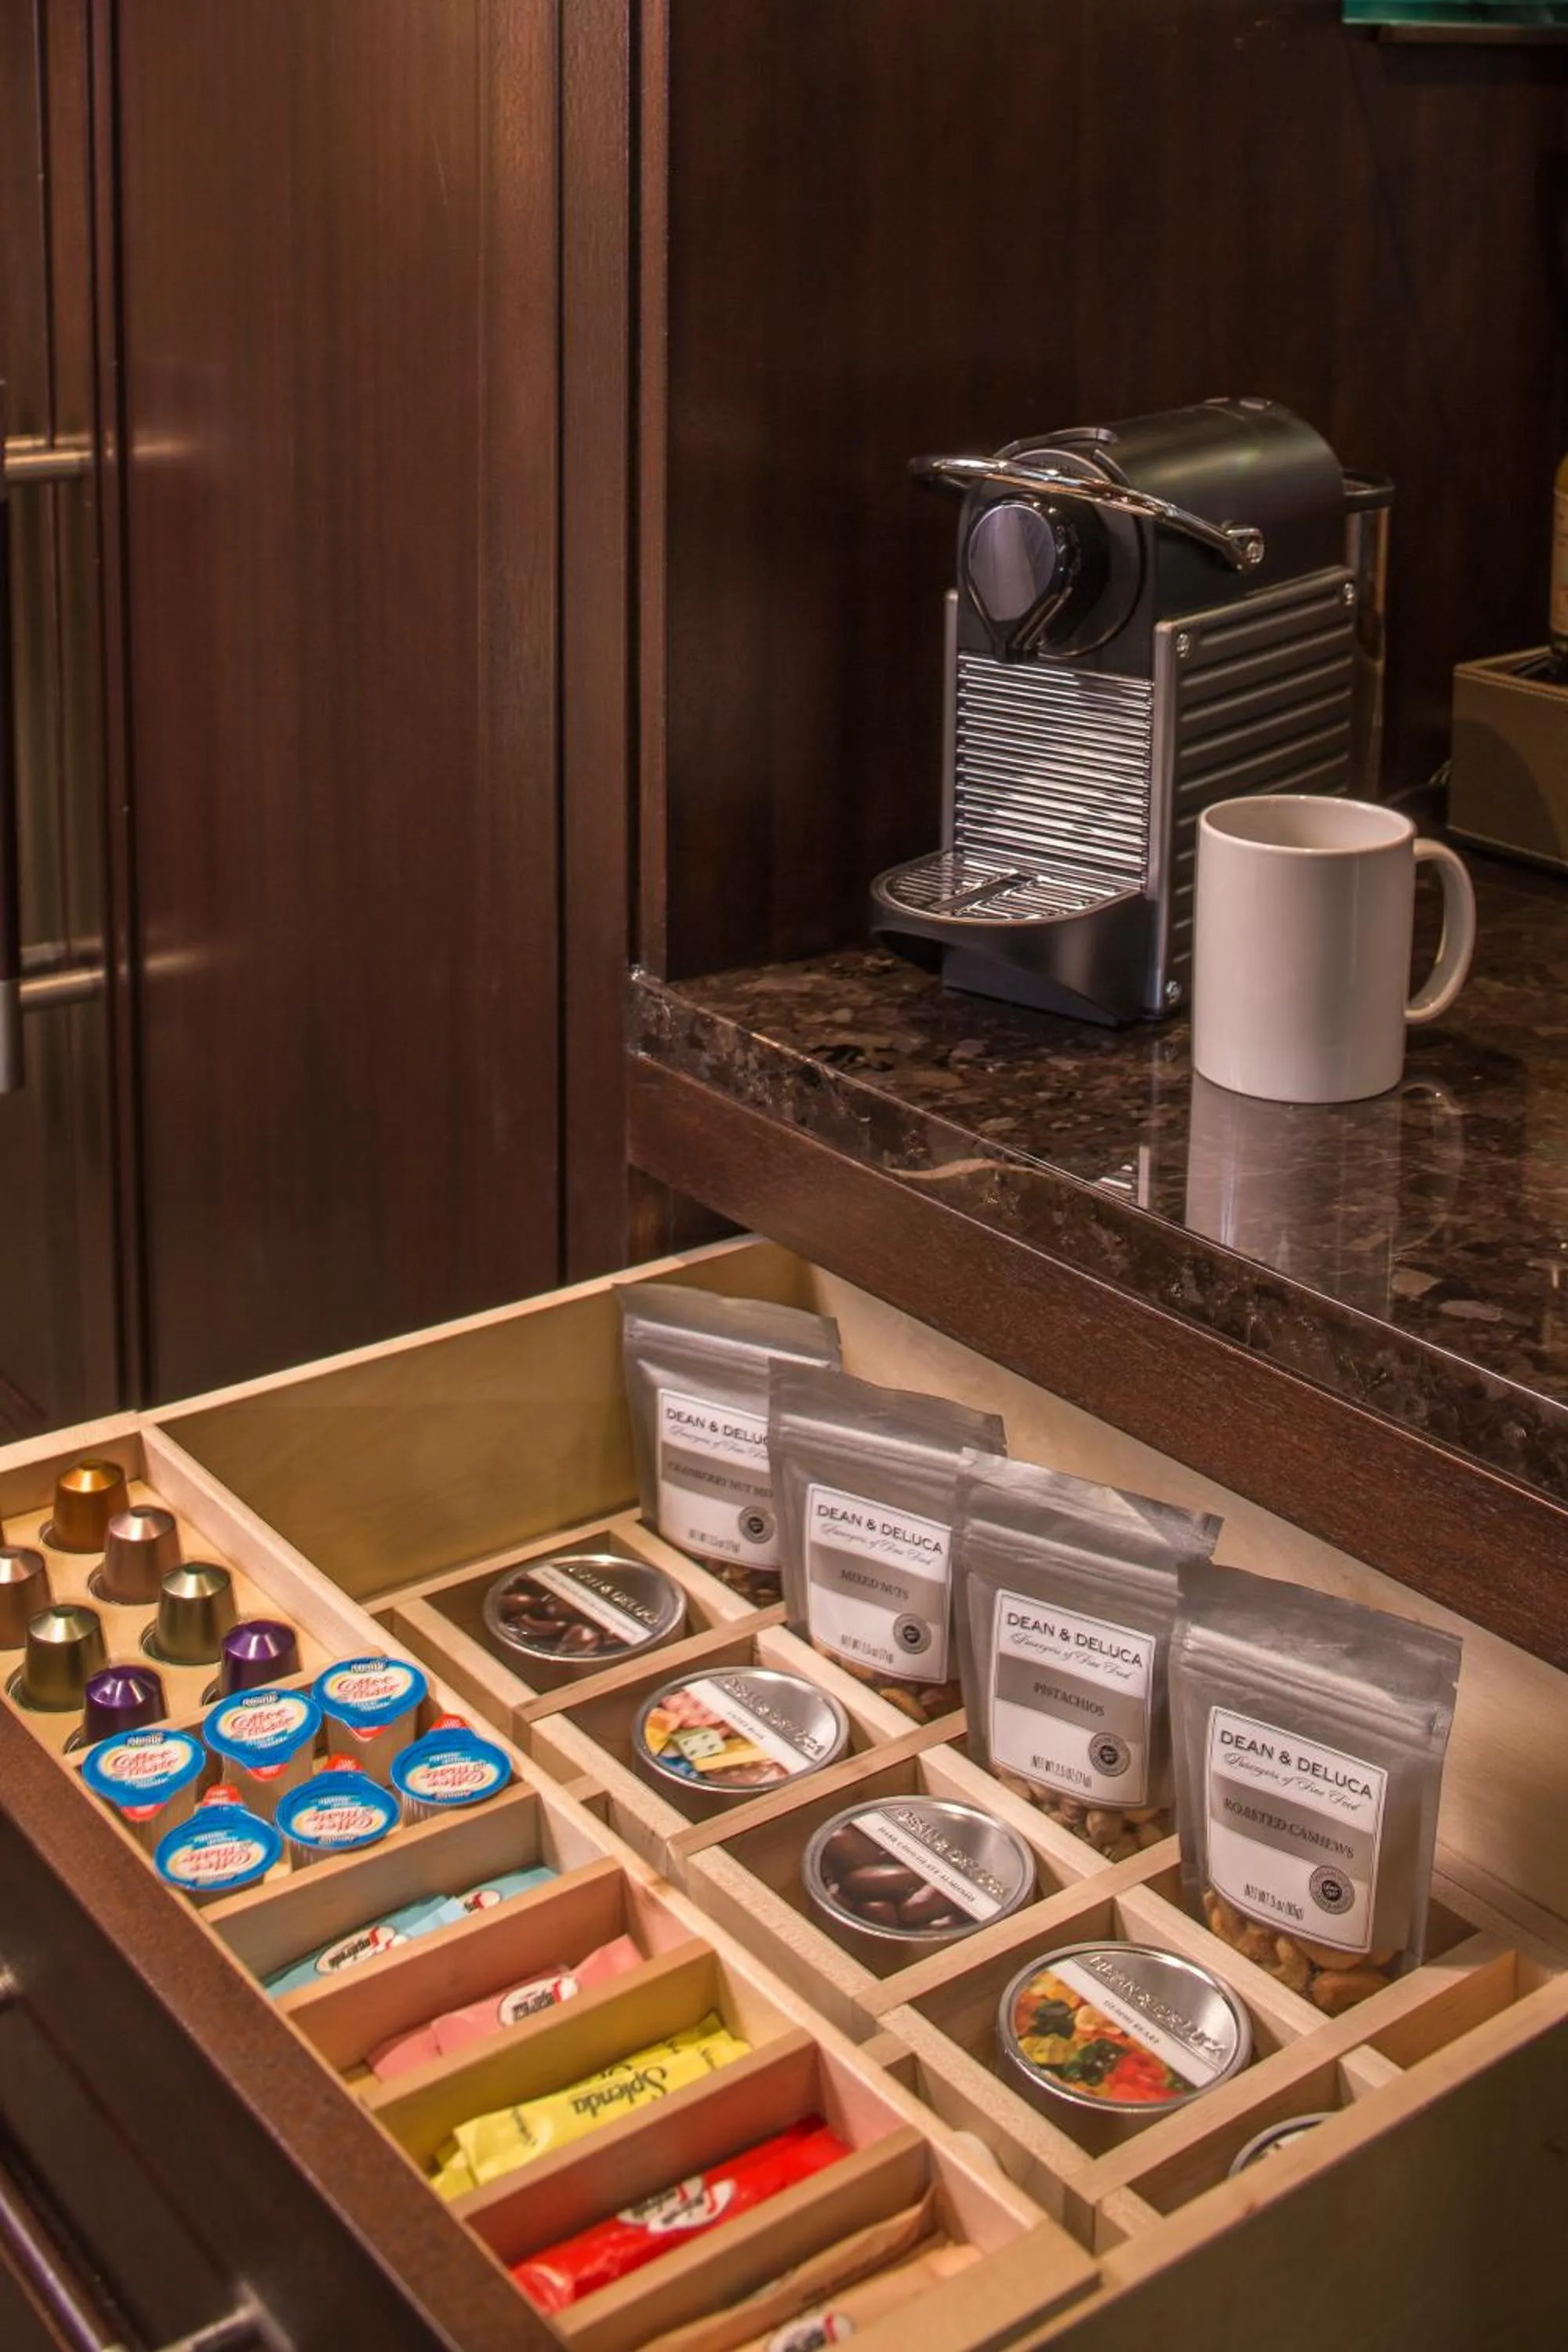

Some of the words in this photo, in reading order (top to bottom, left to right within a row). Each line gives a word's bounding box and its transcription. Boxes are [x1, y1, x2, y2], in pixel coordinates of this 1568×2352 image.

[666, 1407, 706, 1428] DEAN
[710, 1421, 719, 1433] &
[723, 1425, 768, 1446] DELUC
[817, 1504, 863, 1527] DEAN
[866, 1518, 877, 1530] &
[880, 1523, 944, 1554] DELUCA
[840, 1569, 880, 1590] MIXED
[880, 1581, 909, 1601] NUTS
[1007, 1611, 1055, 1637] DEAN
[1059, 1628, 1071, 1642] &
[1075, 1632, 1143, 1668] DELUCA
[337, 1675, 394, 1694] Coffee
[1033, 1682, 1105, 1718] PISTACHIOS
[231, 1707, 287, 1730] Coffee
[111, 1748, 173, 1771] Coffee
[1220, 1730, 1275, 1759] DEAN
[1279, 1750, 1292, 1766] &
[1297, 1756, 1374, 1800] DELUCA
[1223, 1796, 1287, 1832] ROASTED
[1289, 1821, 1355, 1859] CASHEWS
[570, 2065, 668, 2118] Splenda
